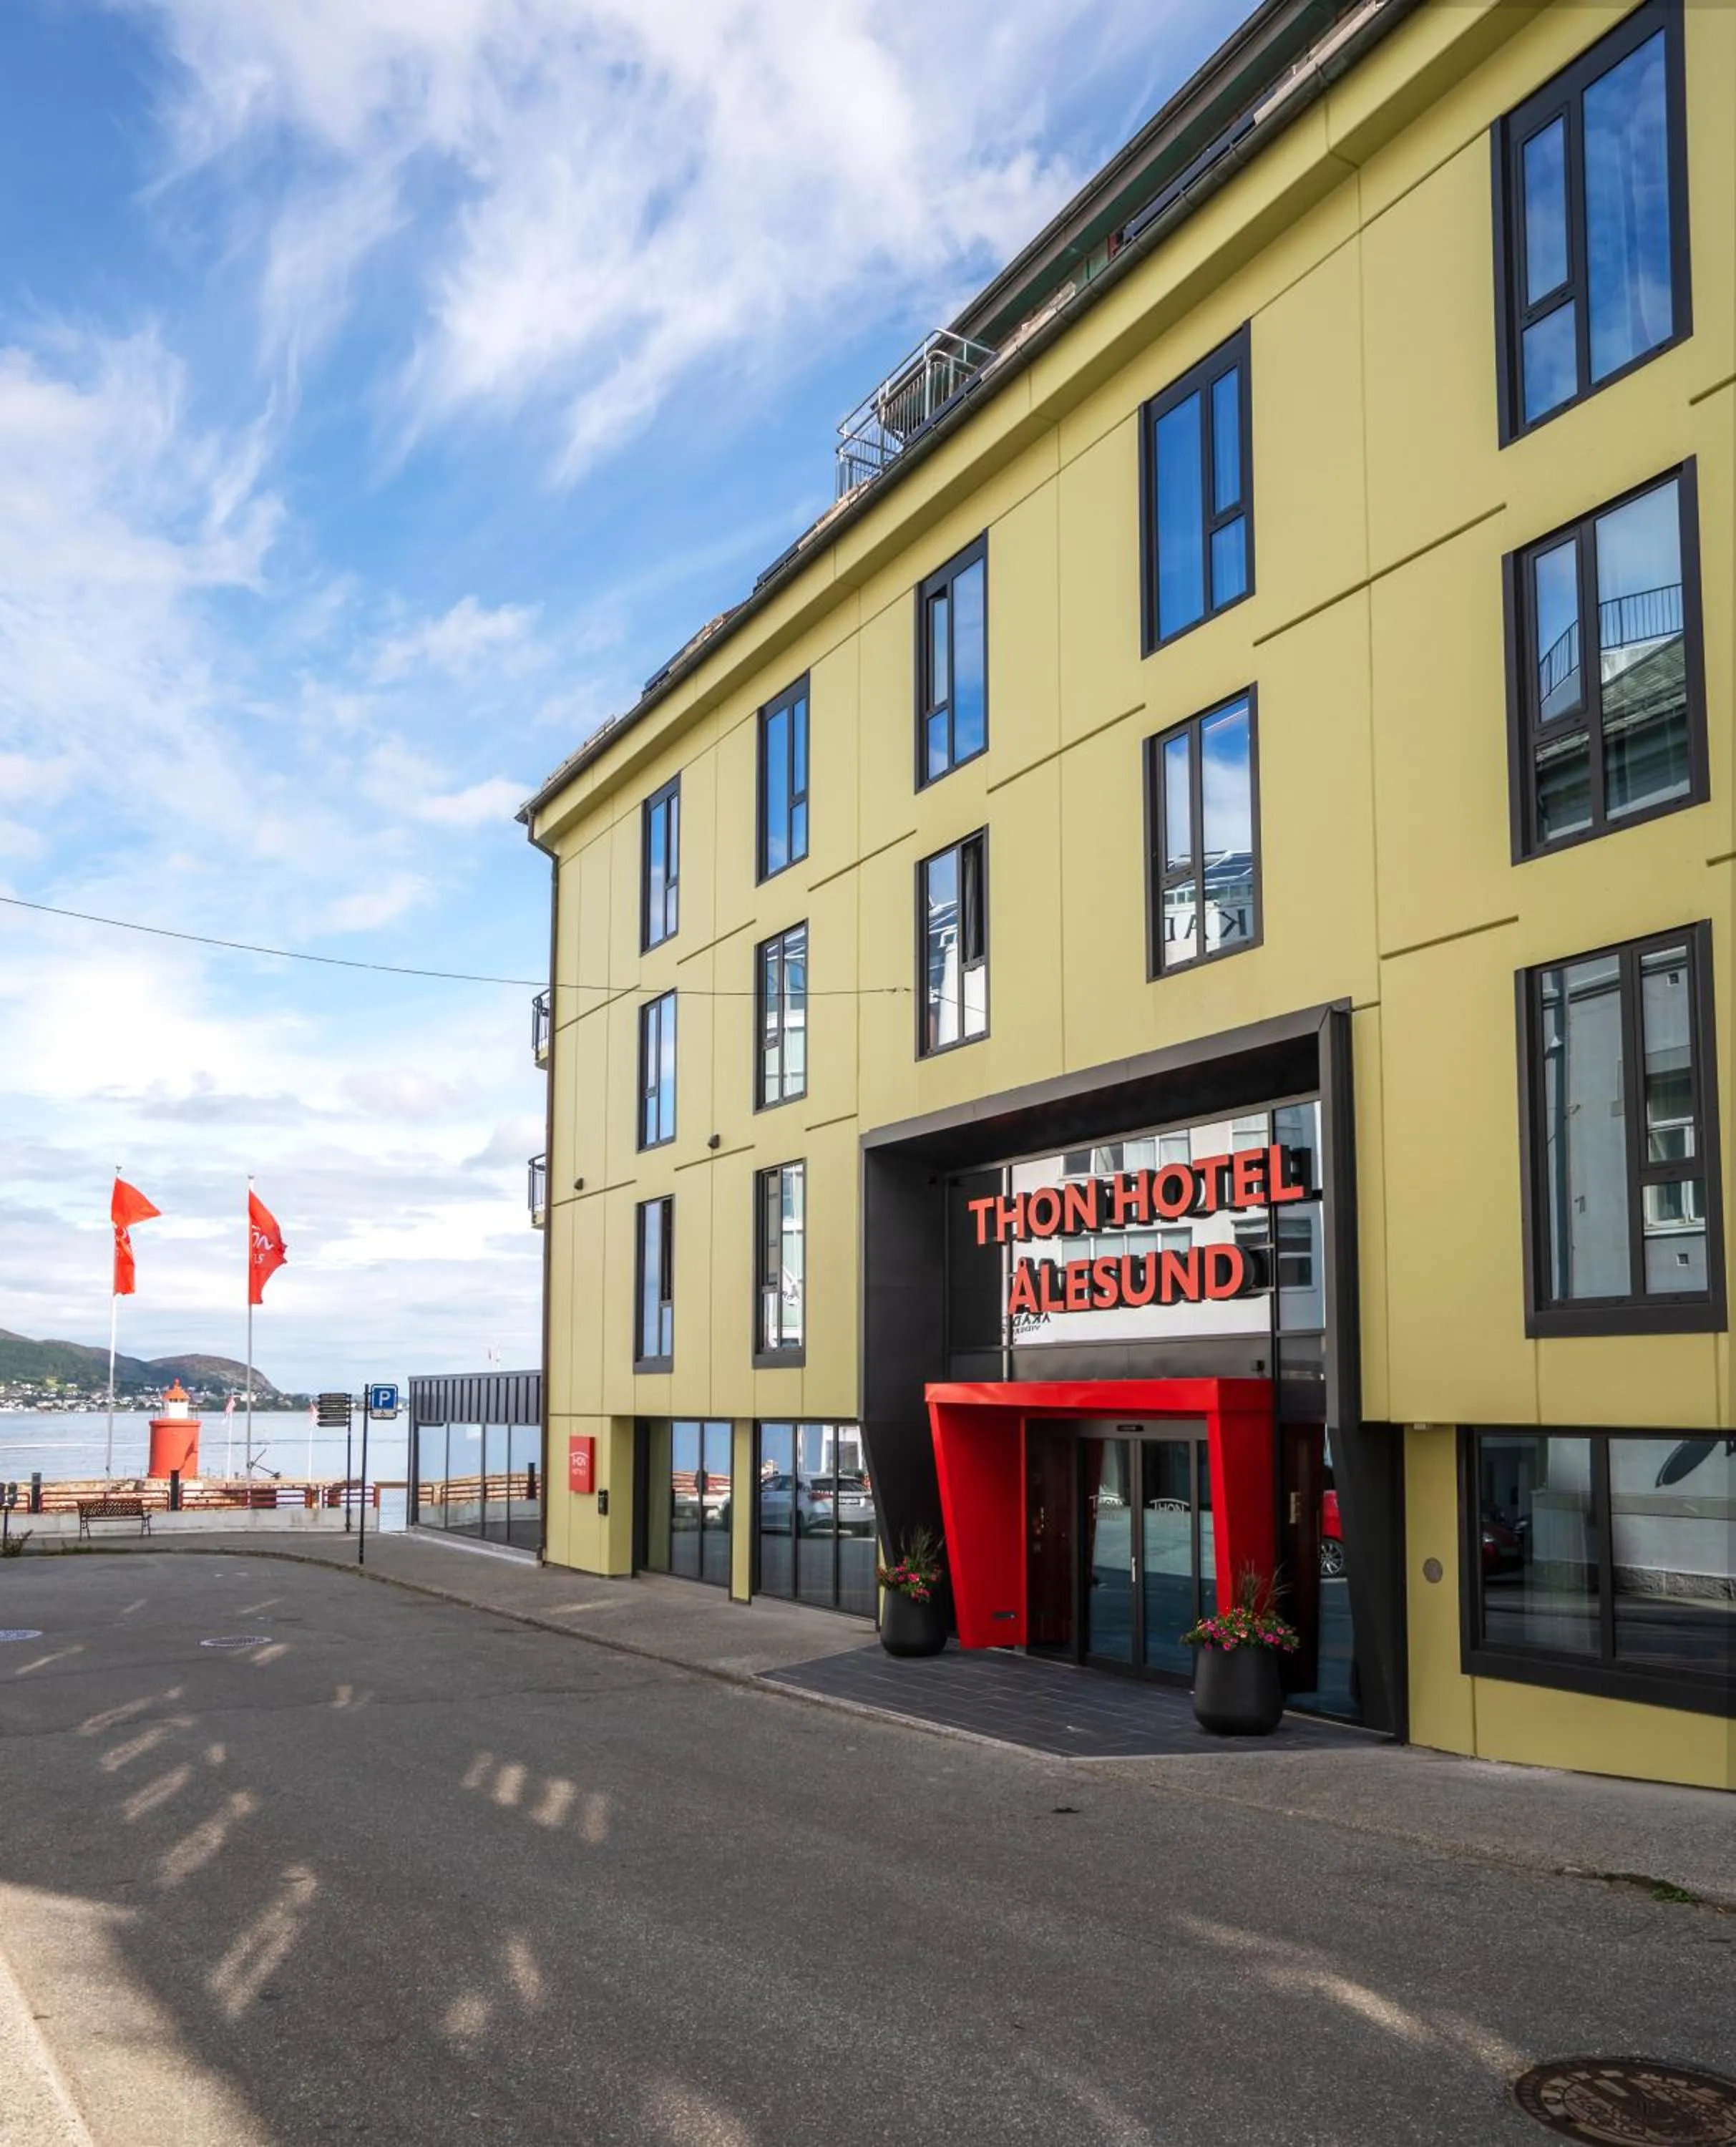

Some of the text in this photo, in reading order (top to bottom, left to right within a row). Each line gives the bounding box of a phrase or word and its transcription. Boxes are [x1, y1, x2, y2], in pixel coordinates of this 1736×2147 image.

[968, 1144, 1304, 1245] THON HOTEL
[1008, 1243, 1244, 1315] ÅLESUND
[379, 1391, 391, 1406] P
